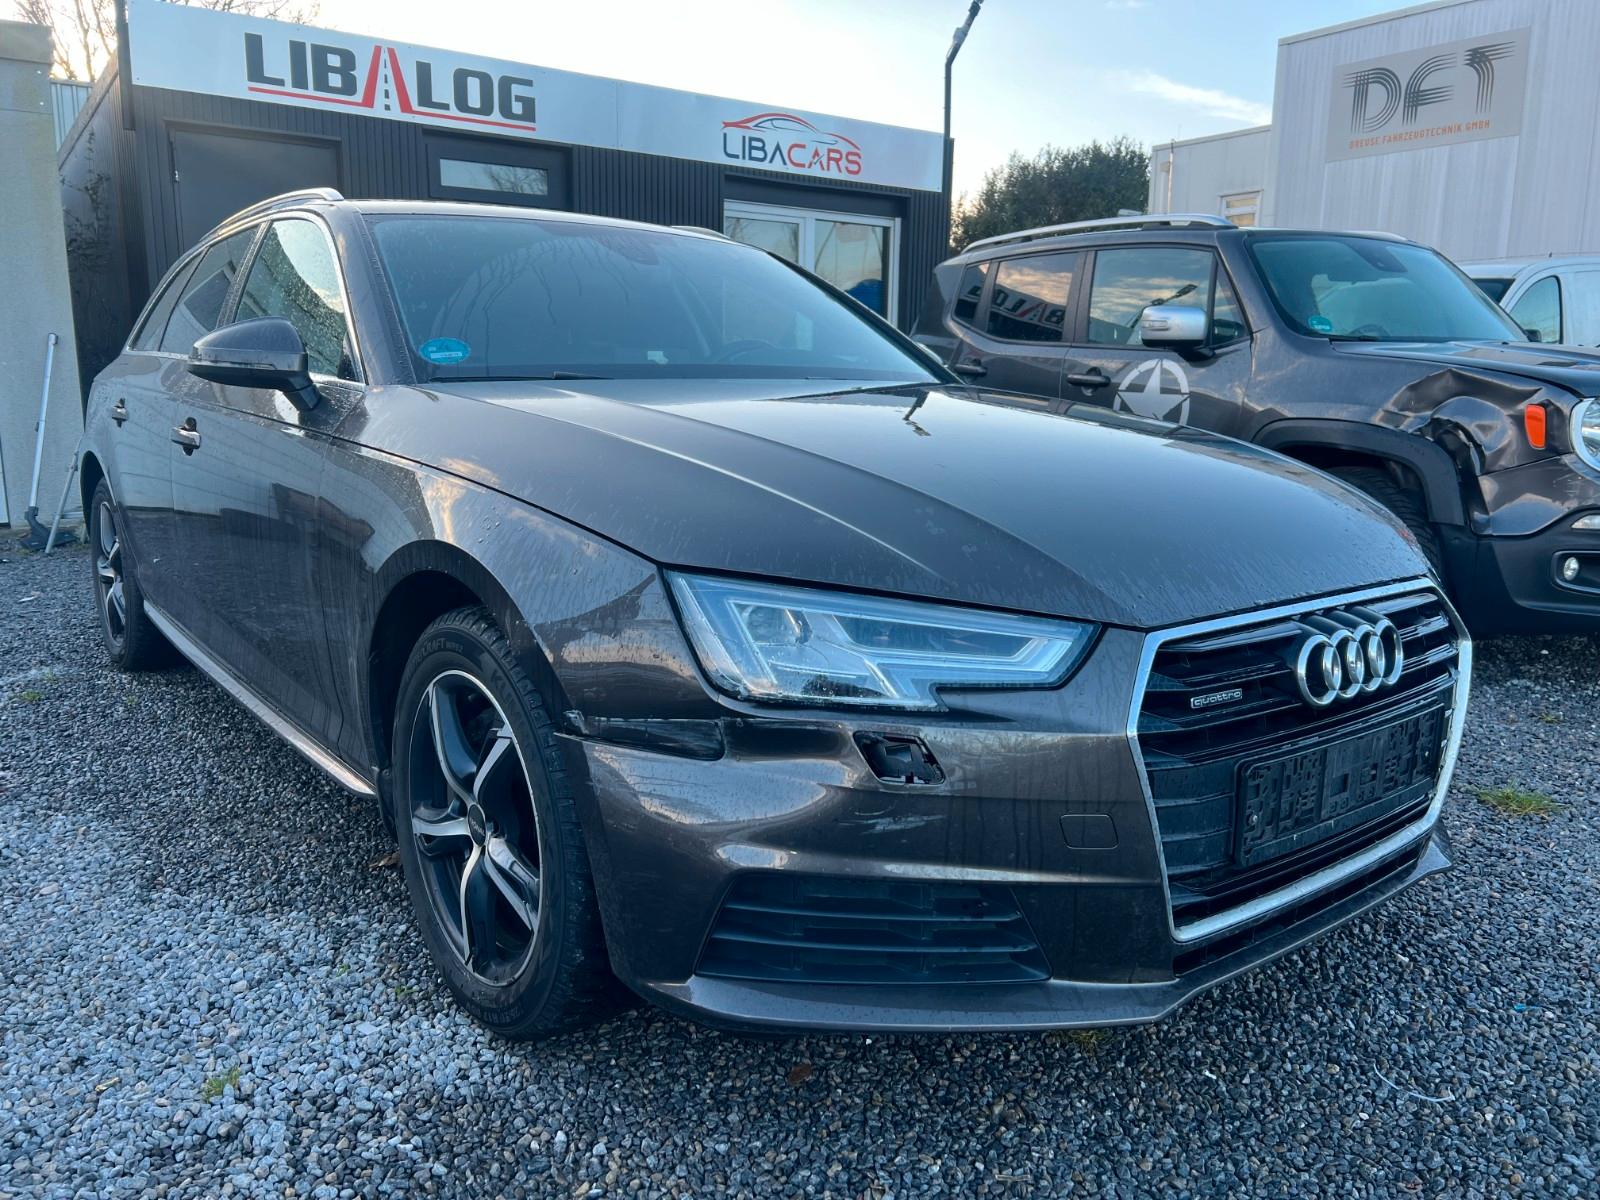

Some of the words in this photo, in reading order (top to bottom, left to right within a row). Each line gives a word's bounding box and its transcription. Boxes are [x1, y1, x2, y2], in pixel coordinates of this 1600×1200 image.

[244, 32, 536, 124] LIBALOG
[723, 132, 862, 175] LIBACARS
[1194, 692, 1241, 706] quattro
